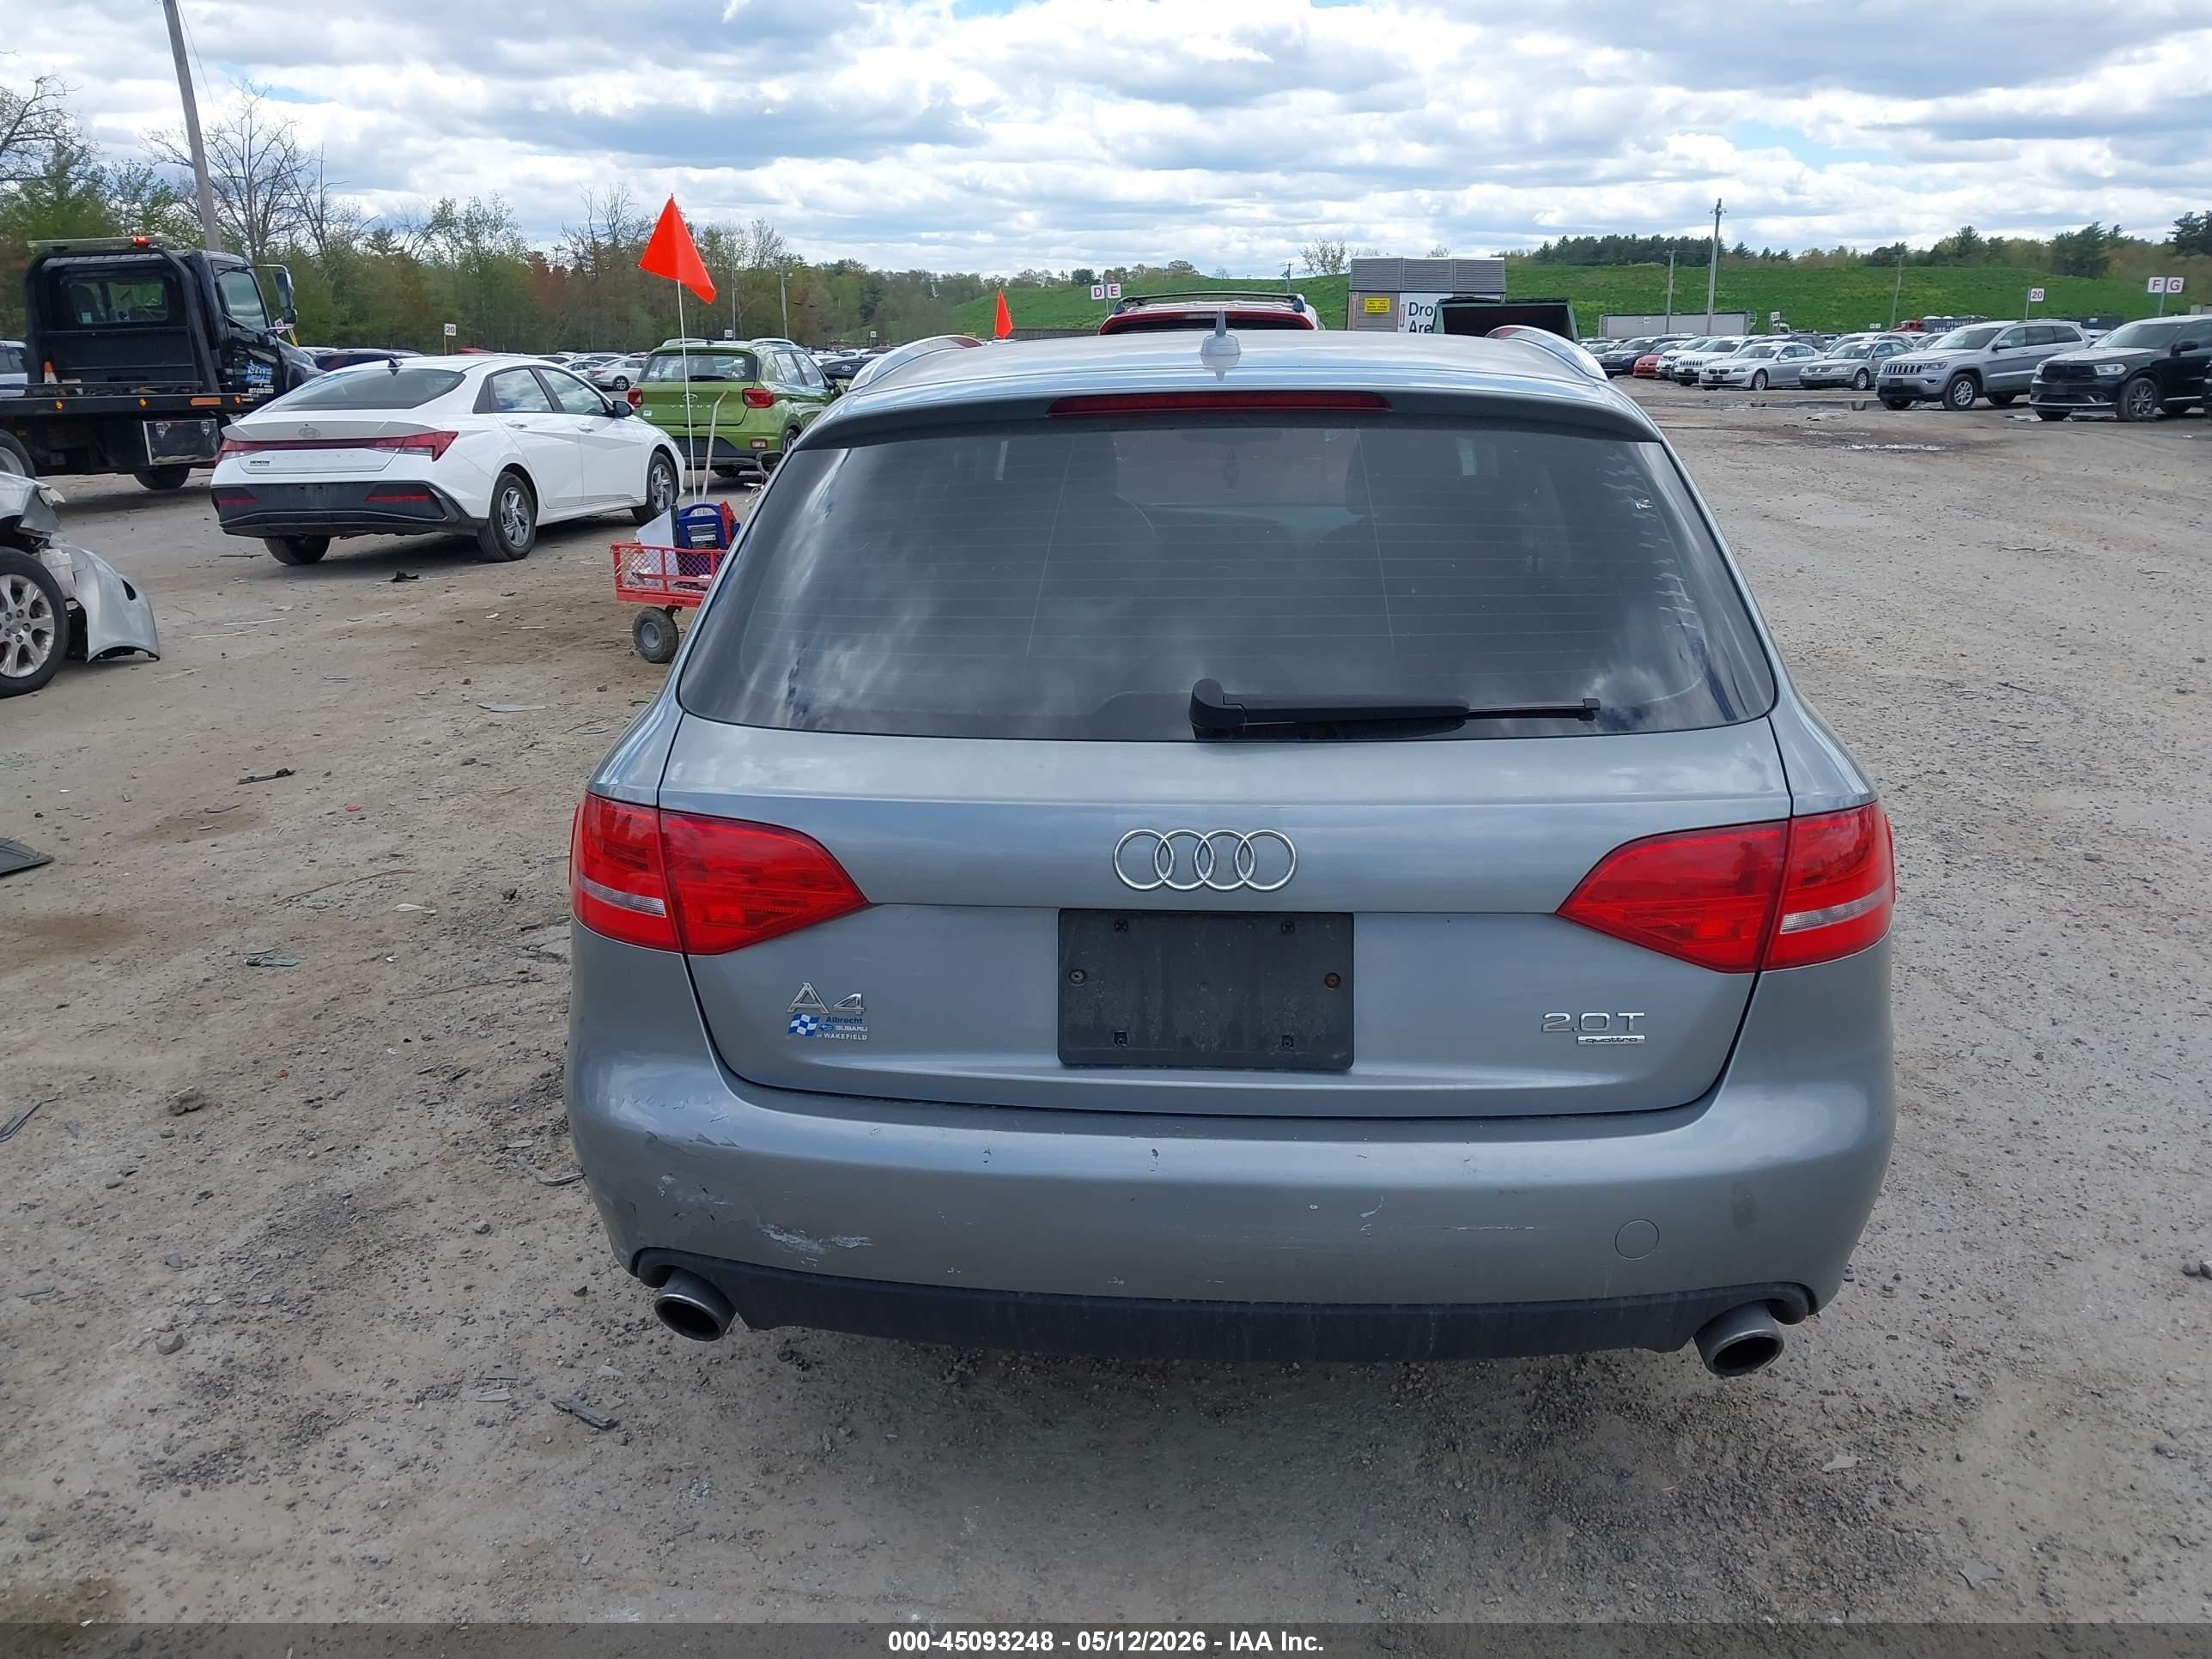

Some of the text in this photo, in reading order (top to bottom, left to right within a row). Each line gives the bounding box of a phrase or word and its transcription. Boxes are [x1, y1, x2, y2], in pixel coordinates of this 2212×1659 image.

[2152, 279, 2160, 290] F
[2170, 279, 2180, 290] G
[1093, 287, 1103, 298] D
[1110, 285, 1119, 296] E
[2032, 290, 2043, 299] 20
[1408, 301, 1437, 317] Dro
[1409, 319, 1436, 333] Are
[785, 981, 866, 1016] A4
[825, 1016, 864, 1025] Albrecht
[1540, 1011, 1646, 1033] 2.0T
[823, 1032, 868, 1041] WAKEFIELD
